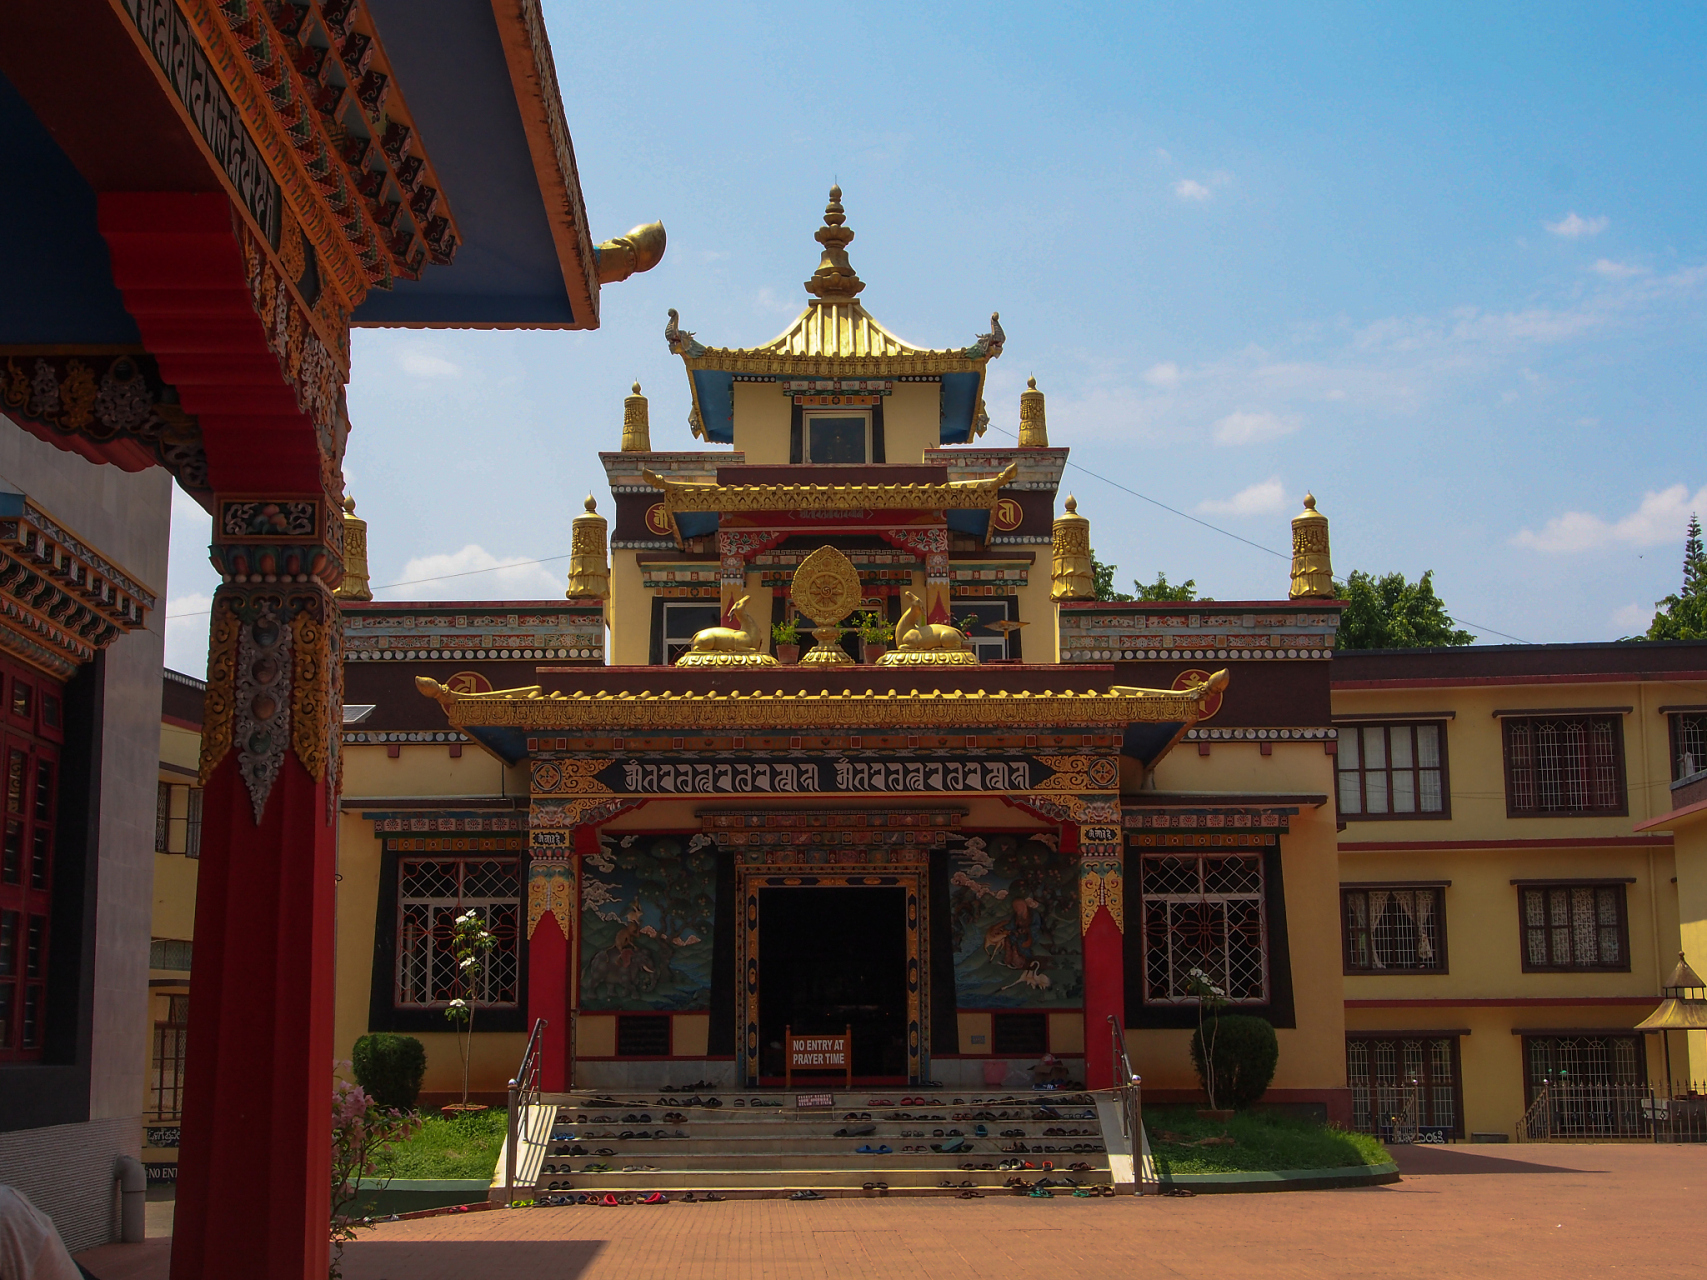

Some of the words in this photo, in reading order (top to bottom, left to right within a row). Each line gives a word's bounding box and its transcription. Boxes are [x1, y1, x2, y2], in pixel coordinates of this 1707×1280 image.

[793, 1040, 804, 1051] NO
[807, 1040, 832, 1050] ENTRY
[834, 1040, 844, 1050] AT
[793, 1053, 824, 1064] PRAYER
[825, 1053, 844, 1064] TIME
[149, 1168, 160, 1178] NO
[163, 1168, 178, 1178] ENT
